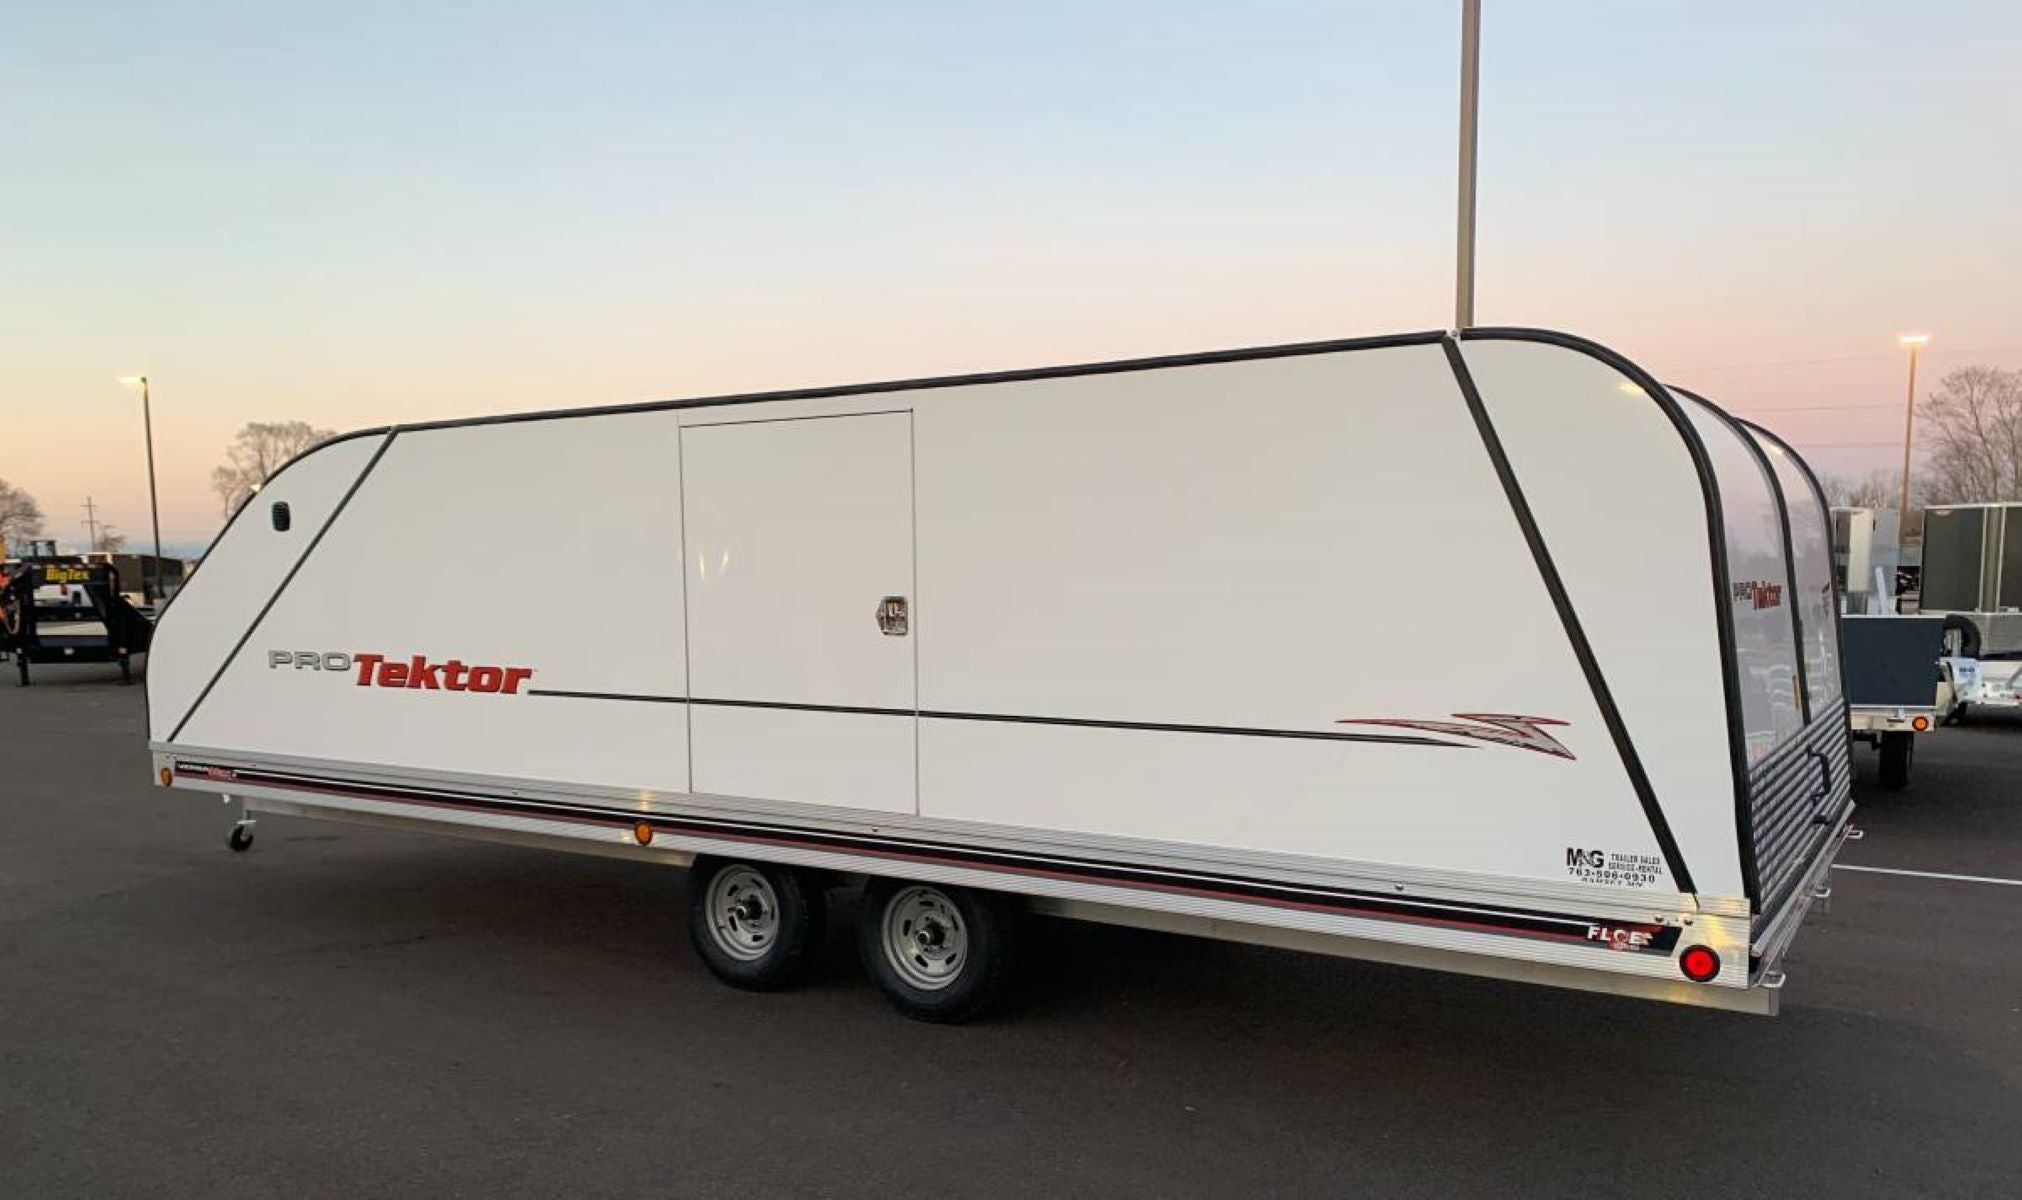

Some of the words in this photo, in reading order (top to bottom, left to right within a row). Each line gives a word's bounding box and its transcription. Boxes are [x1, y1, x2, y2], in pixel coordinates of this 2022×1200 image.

[268, 650, 351, 671] PRO
[353, 654, 533, 694] Tektor
[1587, 926, 1650, 946] FLOE
